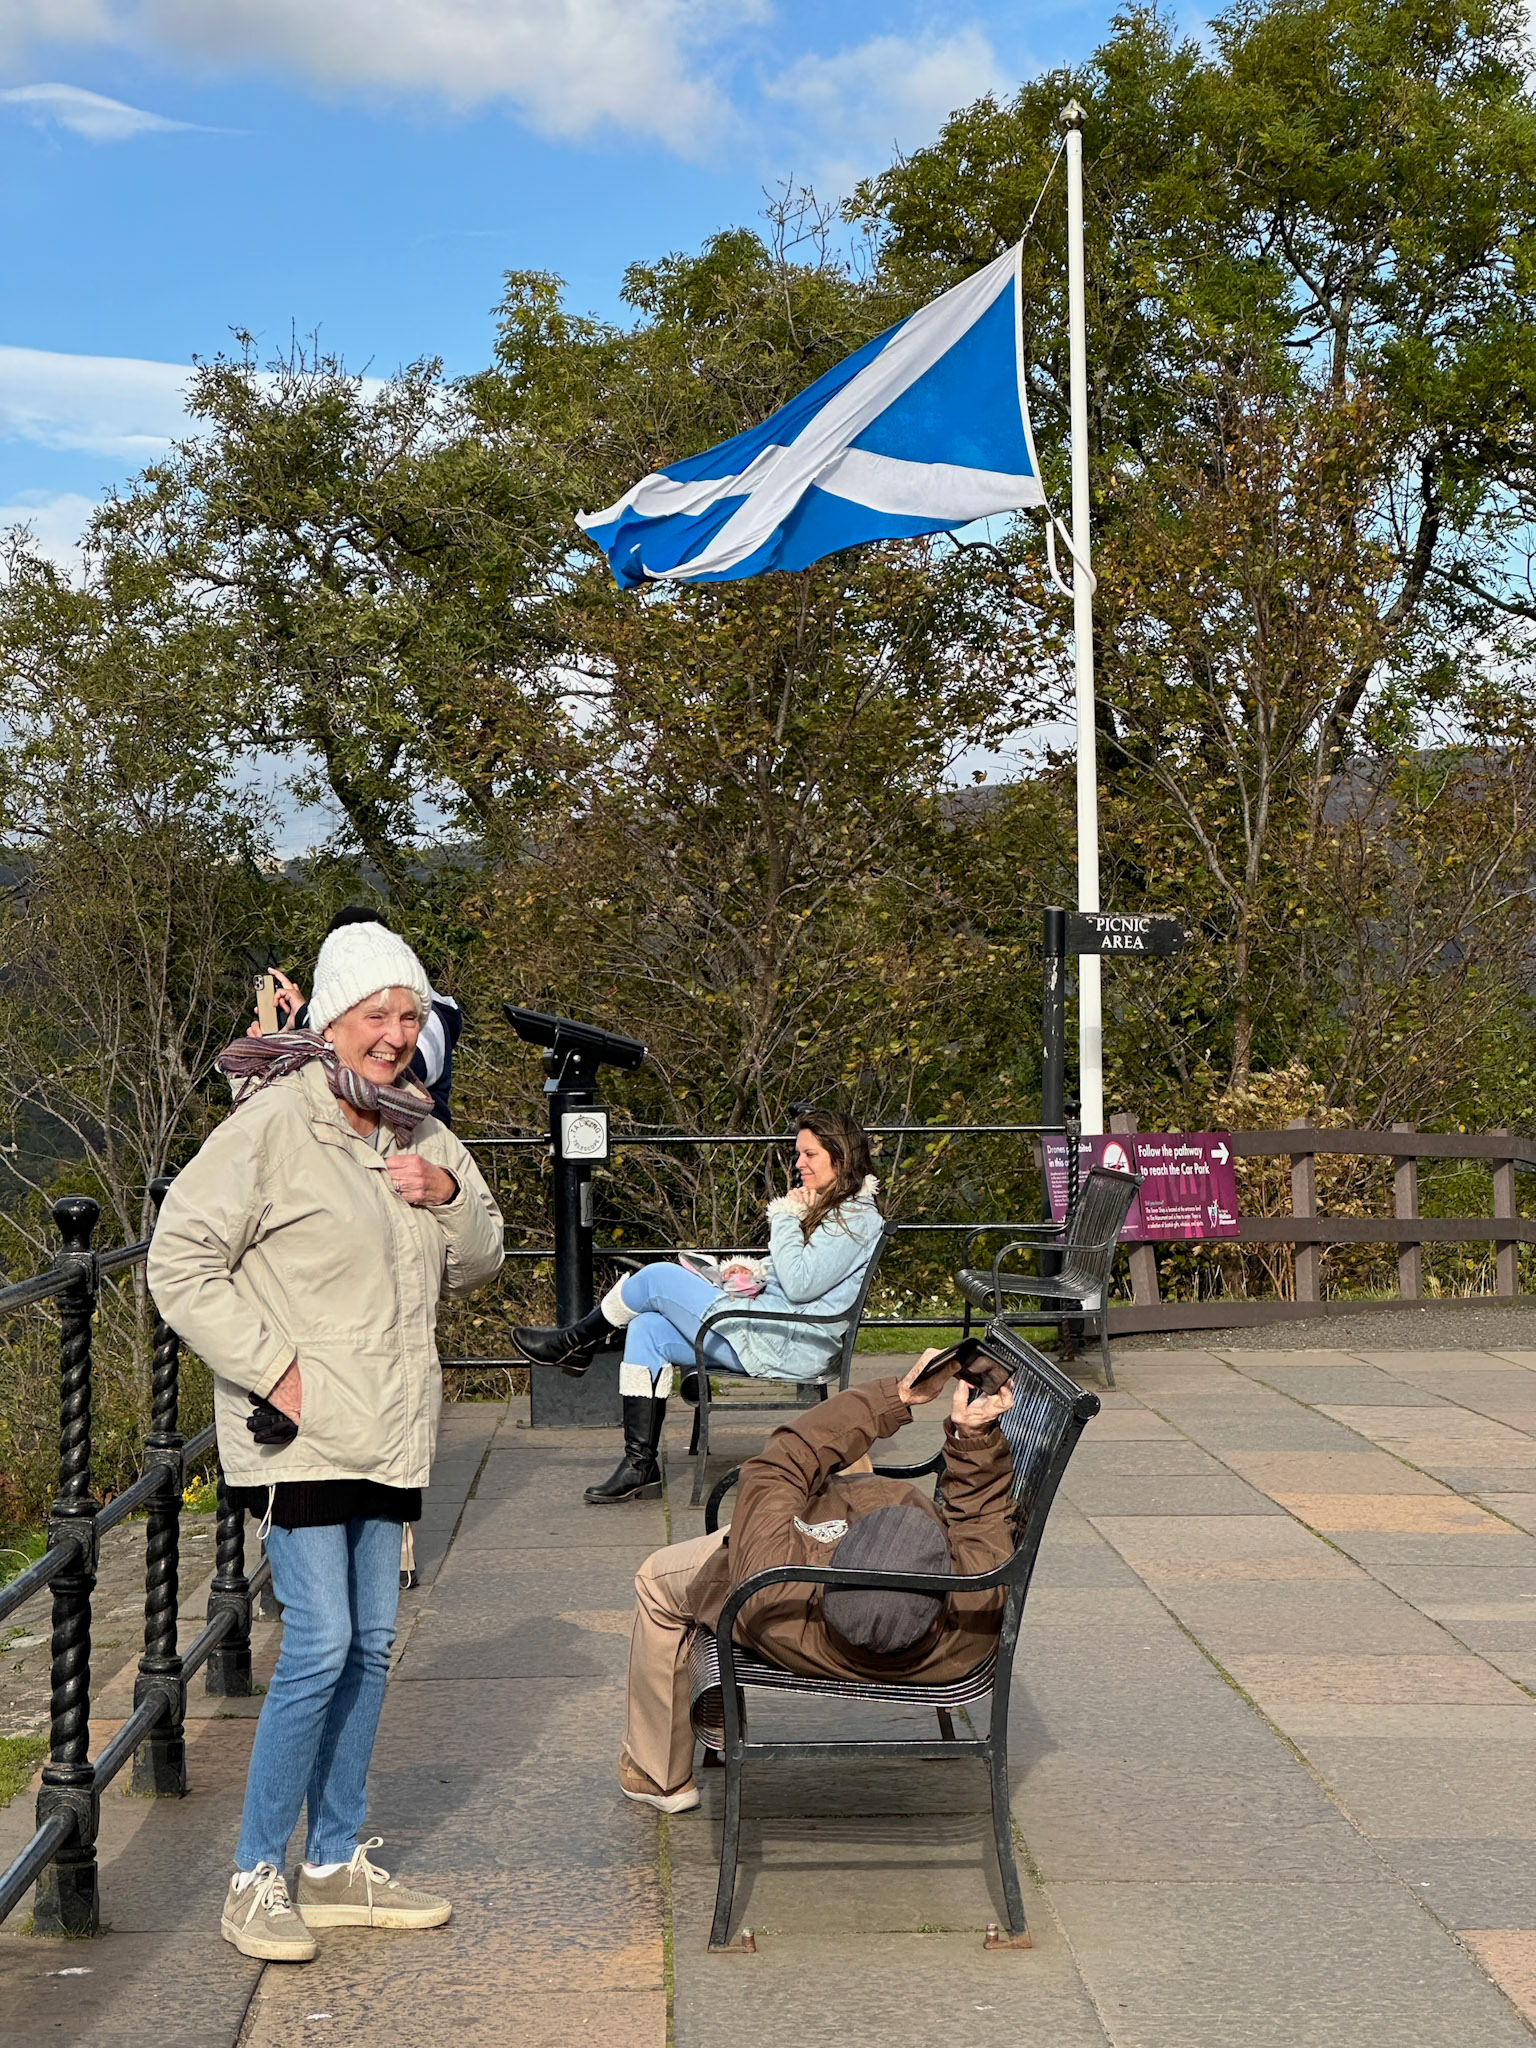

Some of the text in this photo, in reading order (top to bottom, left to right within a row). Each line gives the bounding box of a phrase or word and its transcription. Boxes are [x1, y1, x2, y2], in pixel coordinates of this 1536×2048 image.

[1096, 917, 1151, 932] PICNIC
[1101, 935, 1144, 949] AREA
[570, 1120, 601, 1134] TALKING
[573, 1139, 600, 1151] TELESCOPE
[1046, 1145, 1065, 1154] Drones
[1137, 1143, 1203, 1160] Follow the pathway
[1048, 1158, 1054, 1167] in
[1055, 1157, 1064, 1167] this
[1140, 1161, 1210, 1176] to reach the Car Park
